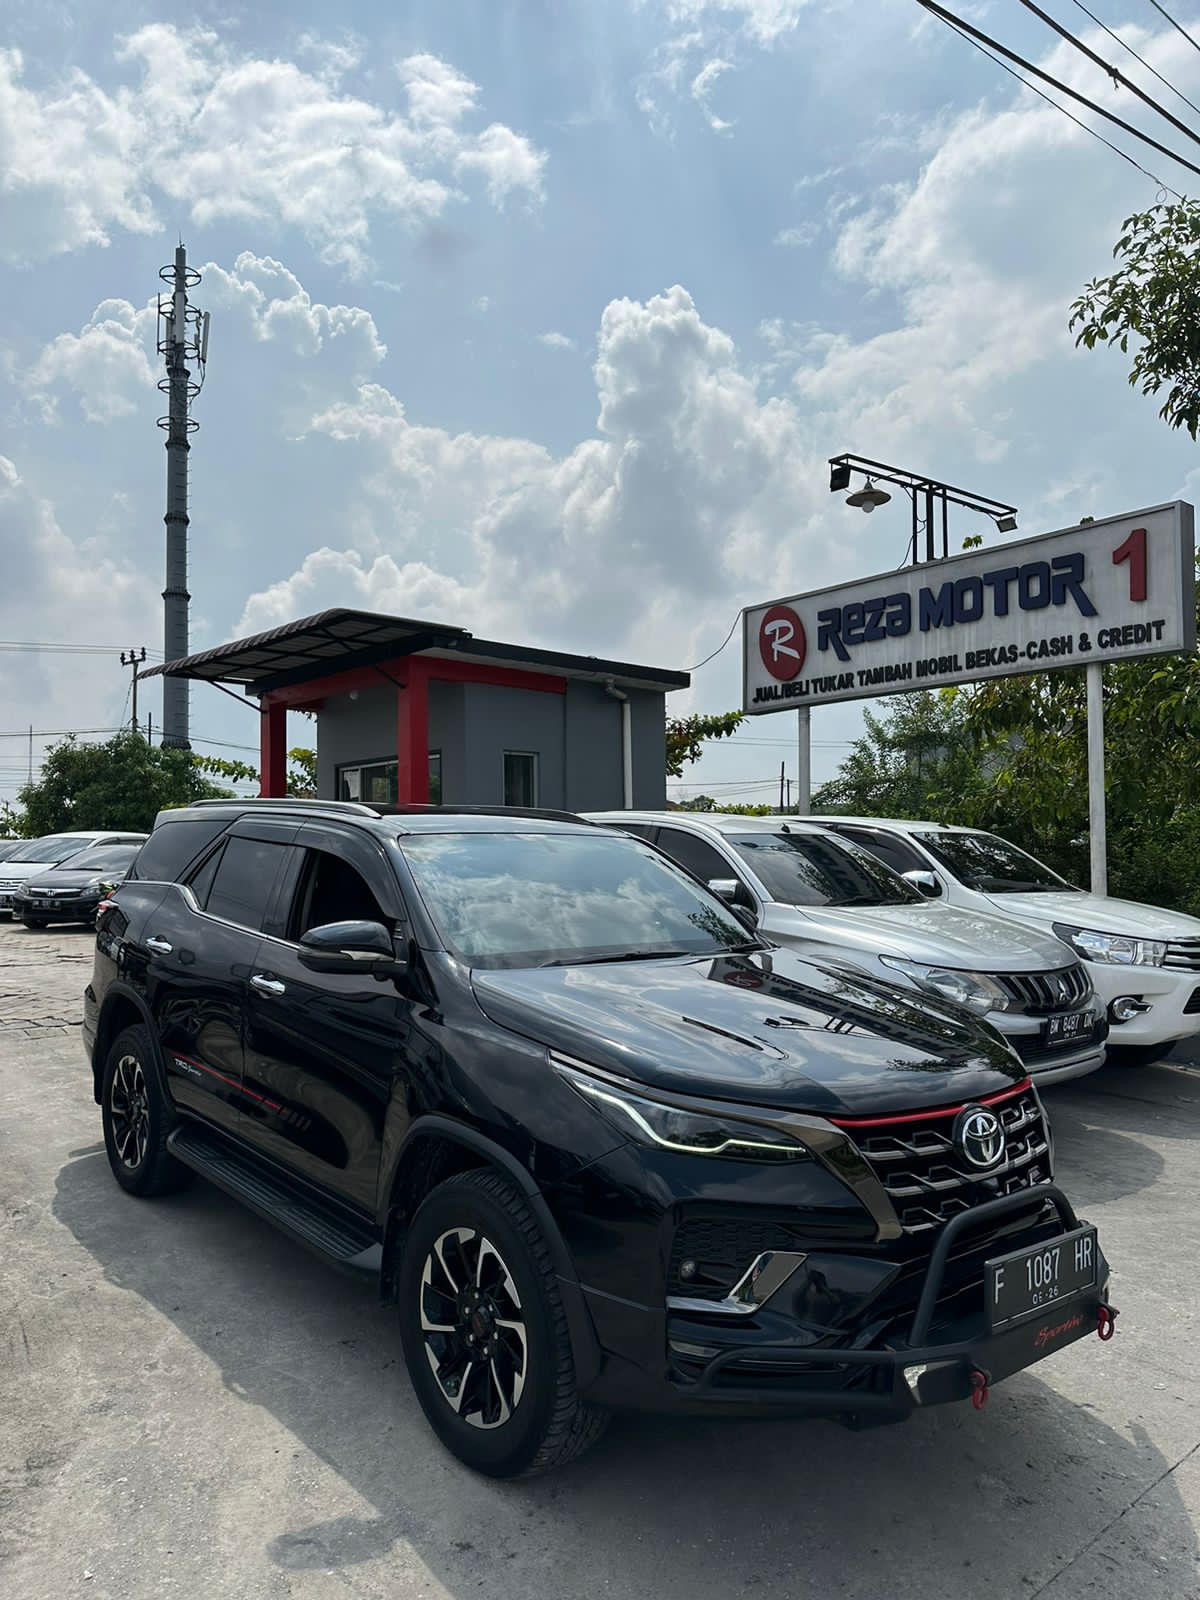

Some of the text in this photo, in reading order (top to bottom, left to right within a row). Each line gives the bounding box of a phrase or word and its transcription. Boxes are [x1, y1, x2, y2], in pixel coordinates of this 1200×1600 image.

[919, 552, 1098, 632] MOTOR
[1112, 528, 1147, 602] 1
[752, 619, 1166, 704] JUAL/BELI TUKAR TAMBAH MOBIL BEKAS-CASH & CREDIT
[764, 619, 801, 662] R
[995, 1237, 1092, 1304] F 1087 HR
